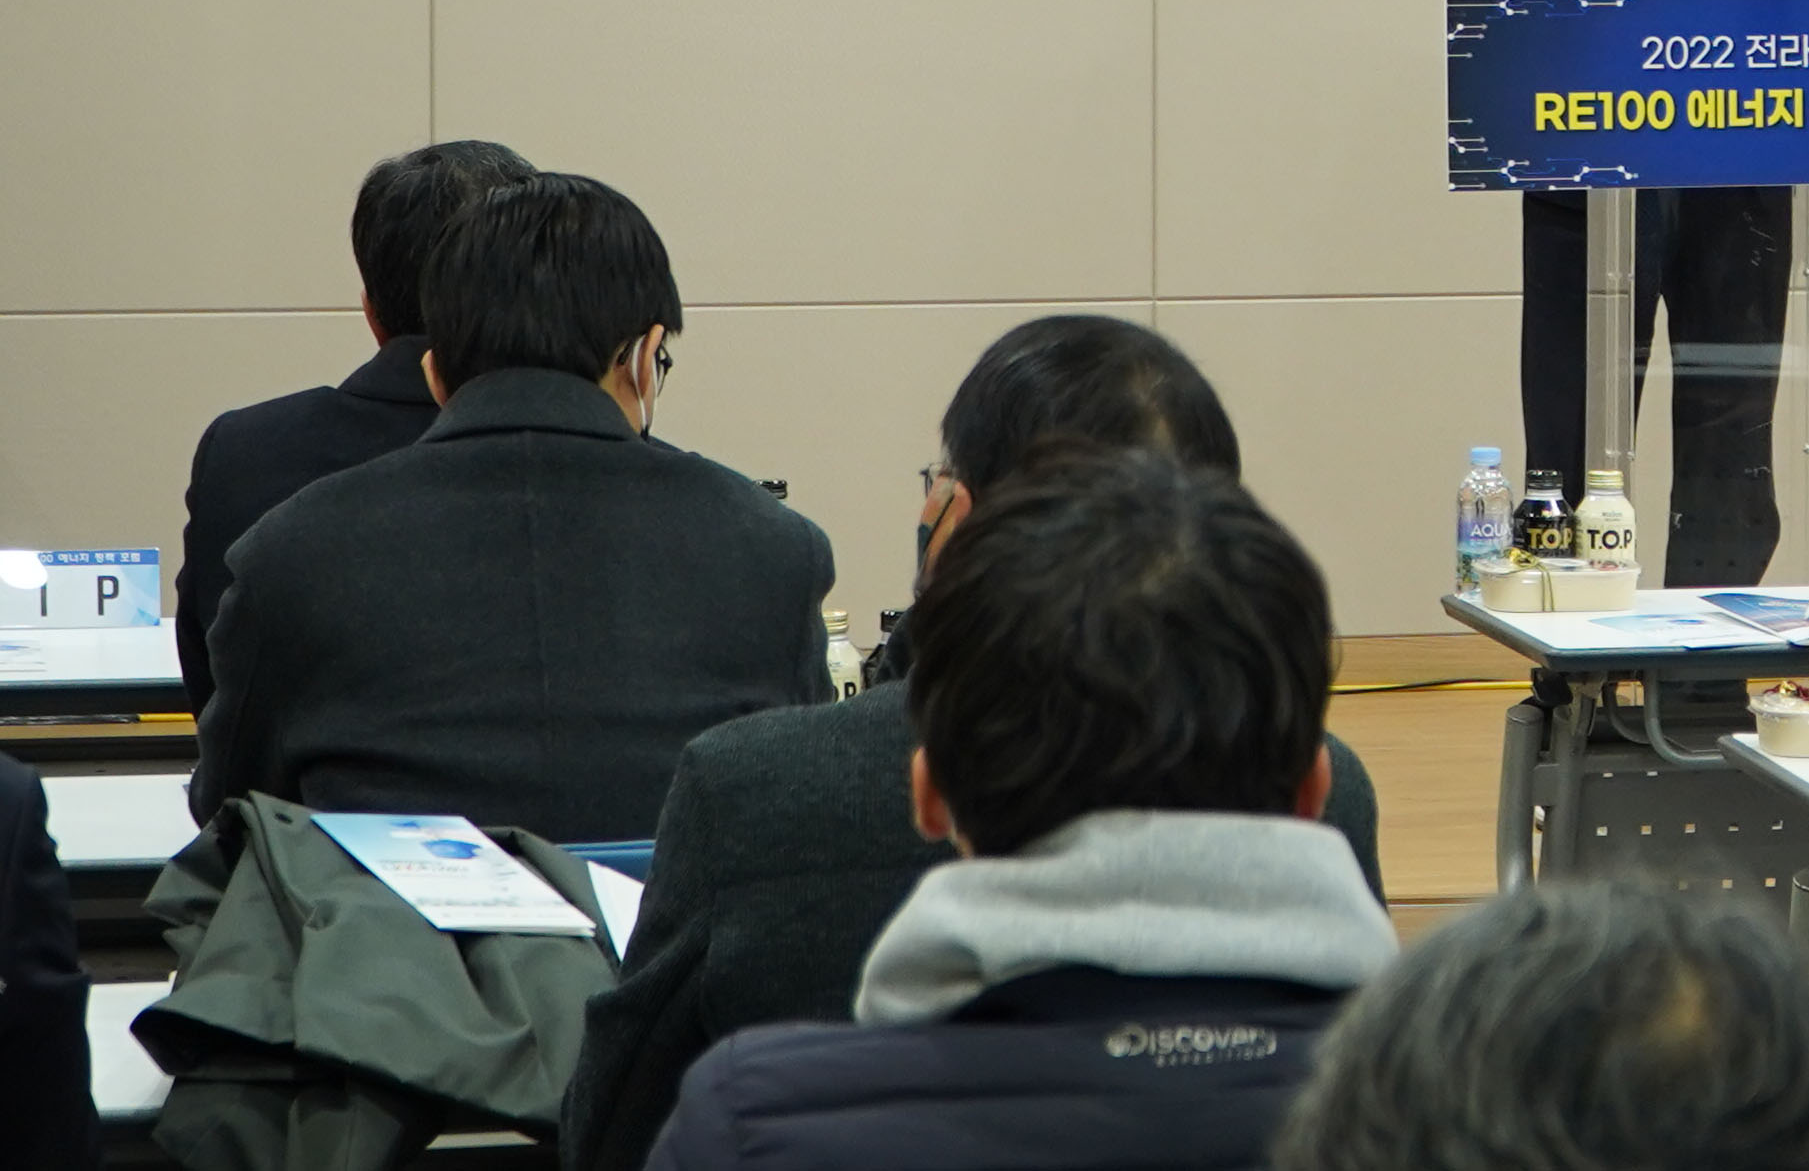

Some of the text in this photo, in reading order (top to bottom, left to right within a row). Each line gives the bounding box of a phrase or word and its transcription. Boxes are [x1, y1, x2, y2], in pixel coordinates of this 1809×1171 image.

[1641, 35, 1735, 70] 2022
[1534, 89, 1676, 131] RE100
[1686, 88, 1804, 130] 에너지
[1527, 527, 1573, 549] T.O.P
[1587, 529, 1633, 549] T.O.P
